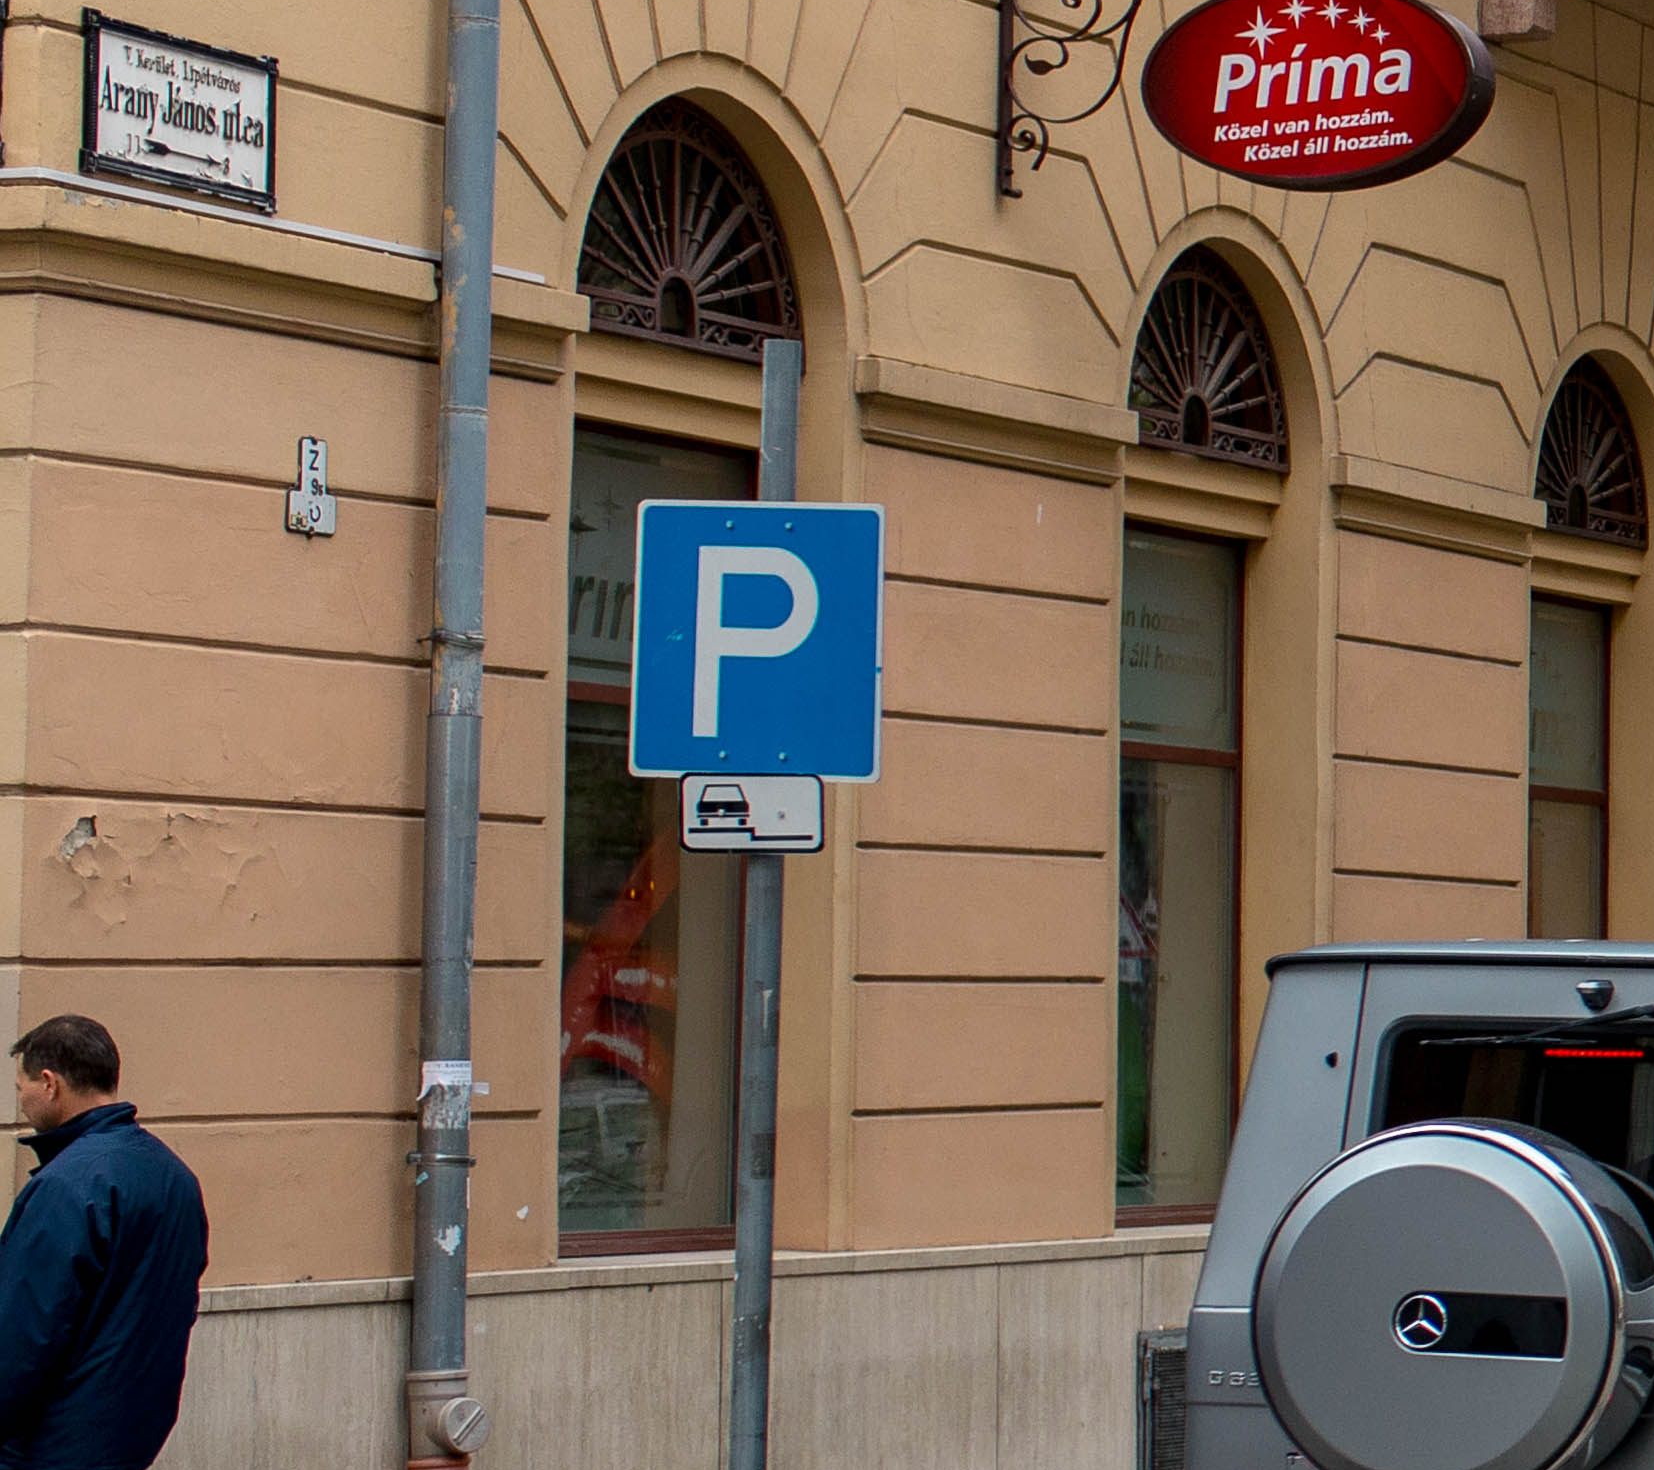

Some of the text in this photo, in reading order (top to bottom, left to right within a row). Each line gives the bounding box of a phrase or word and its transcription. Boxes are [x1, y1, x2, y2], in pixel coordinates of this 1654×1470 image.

[1213, 43, 1413, 114] Príma
[100, 64, 159, 136] Arany
[1214, 108, 1395, 142] Közel van hozzám.
[1244, 131, 1414, 163] Közel áll hozzám.
[309, 449, 319, 471] Z
[692, 544, 820, 738] P
[1208, 1370, 1223, 1386] G
